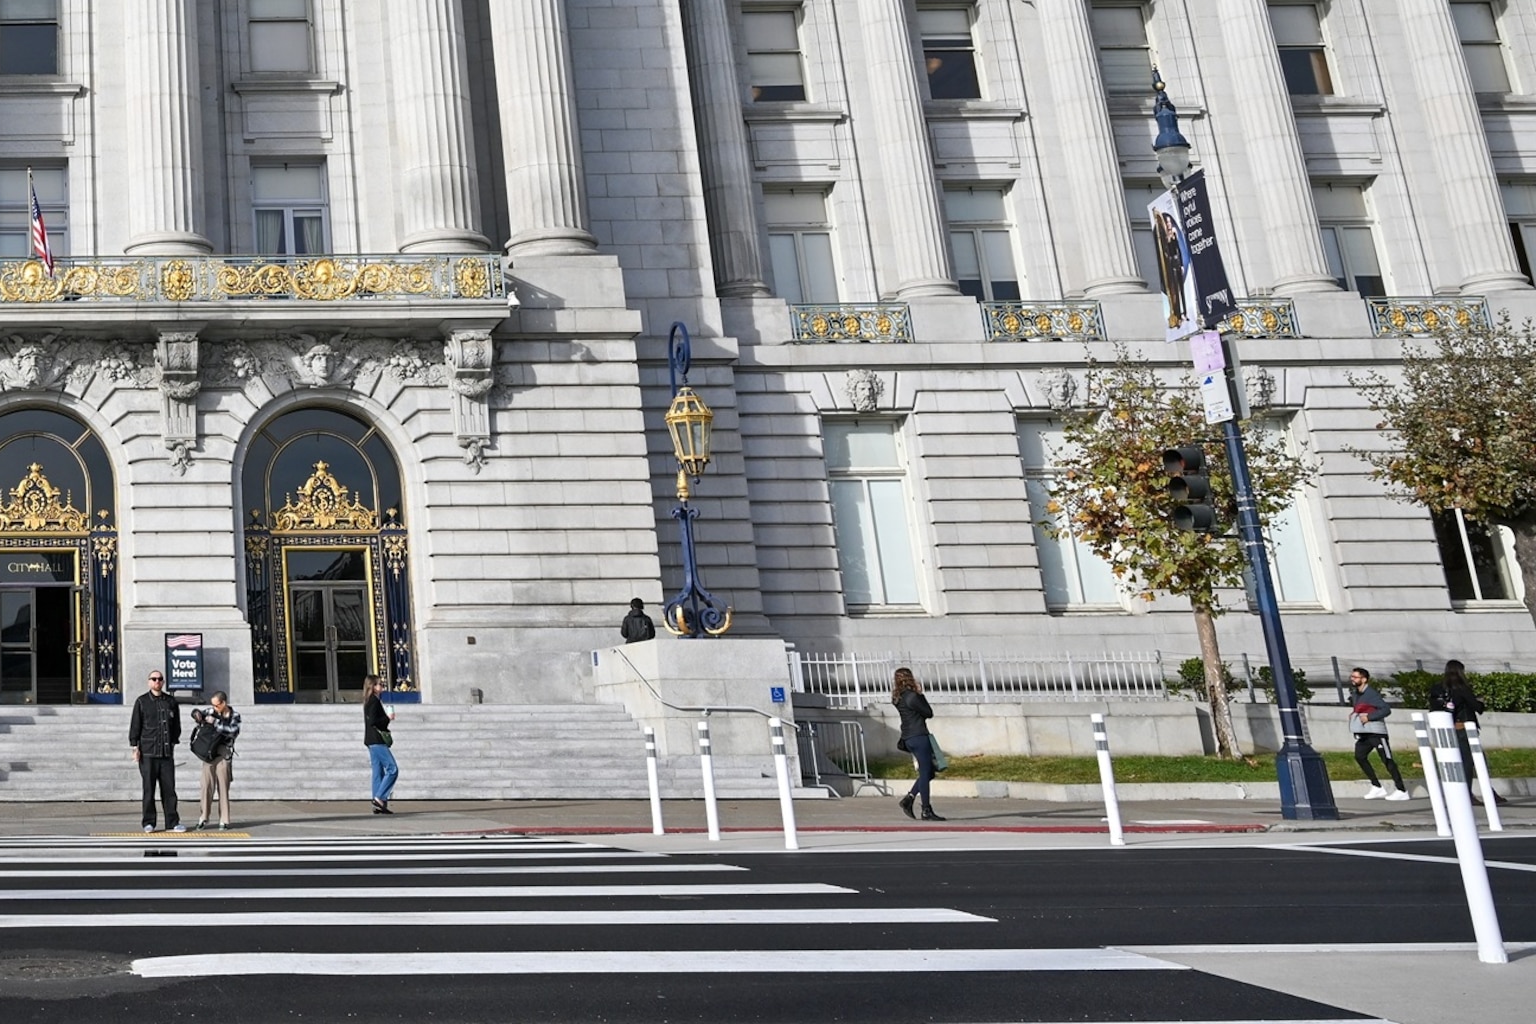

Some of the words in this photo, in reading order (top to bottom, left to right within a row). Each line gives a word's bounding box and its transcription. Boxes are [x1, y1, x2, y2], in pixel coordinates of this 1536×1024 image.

[1180, 187, 1197, 203] Where
[1190, 237, 1214, 255] together
[7, 562, 31, 573] CITY
[34, 562, 64, 573] HALL
[172, 659, 197, 669] Vote
[172, 668, 197, 678] Here!
